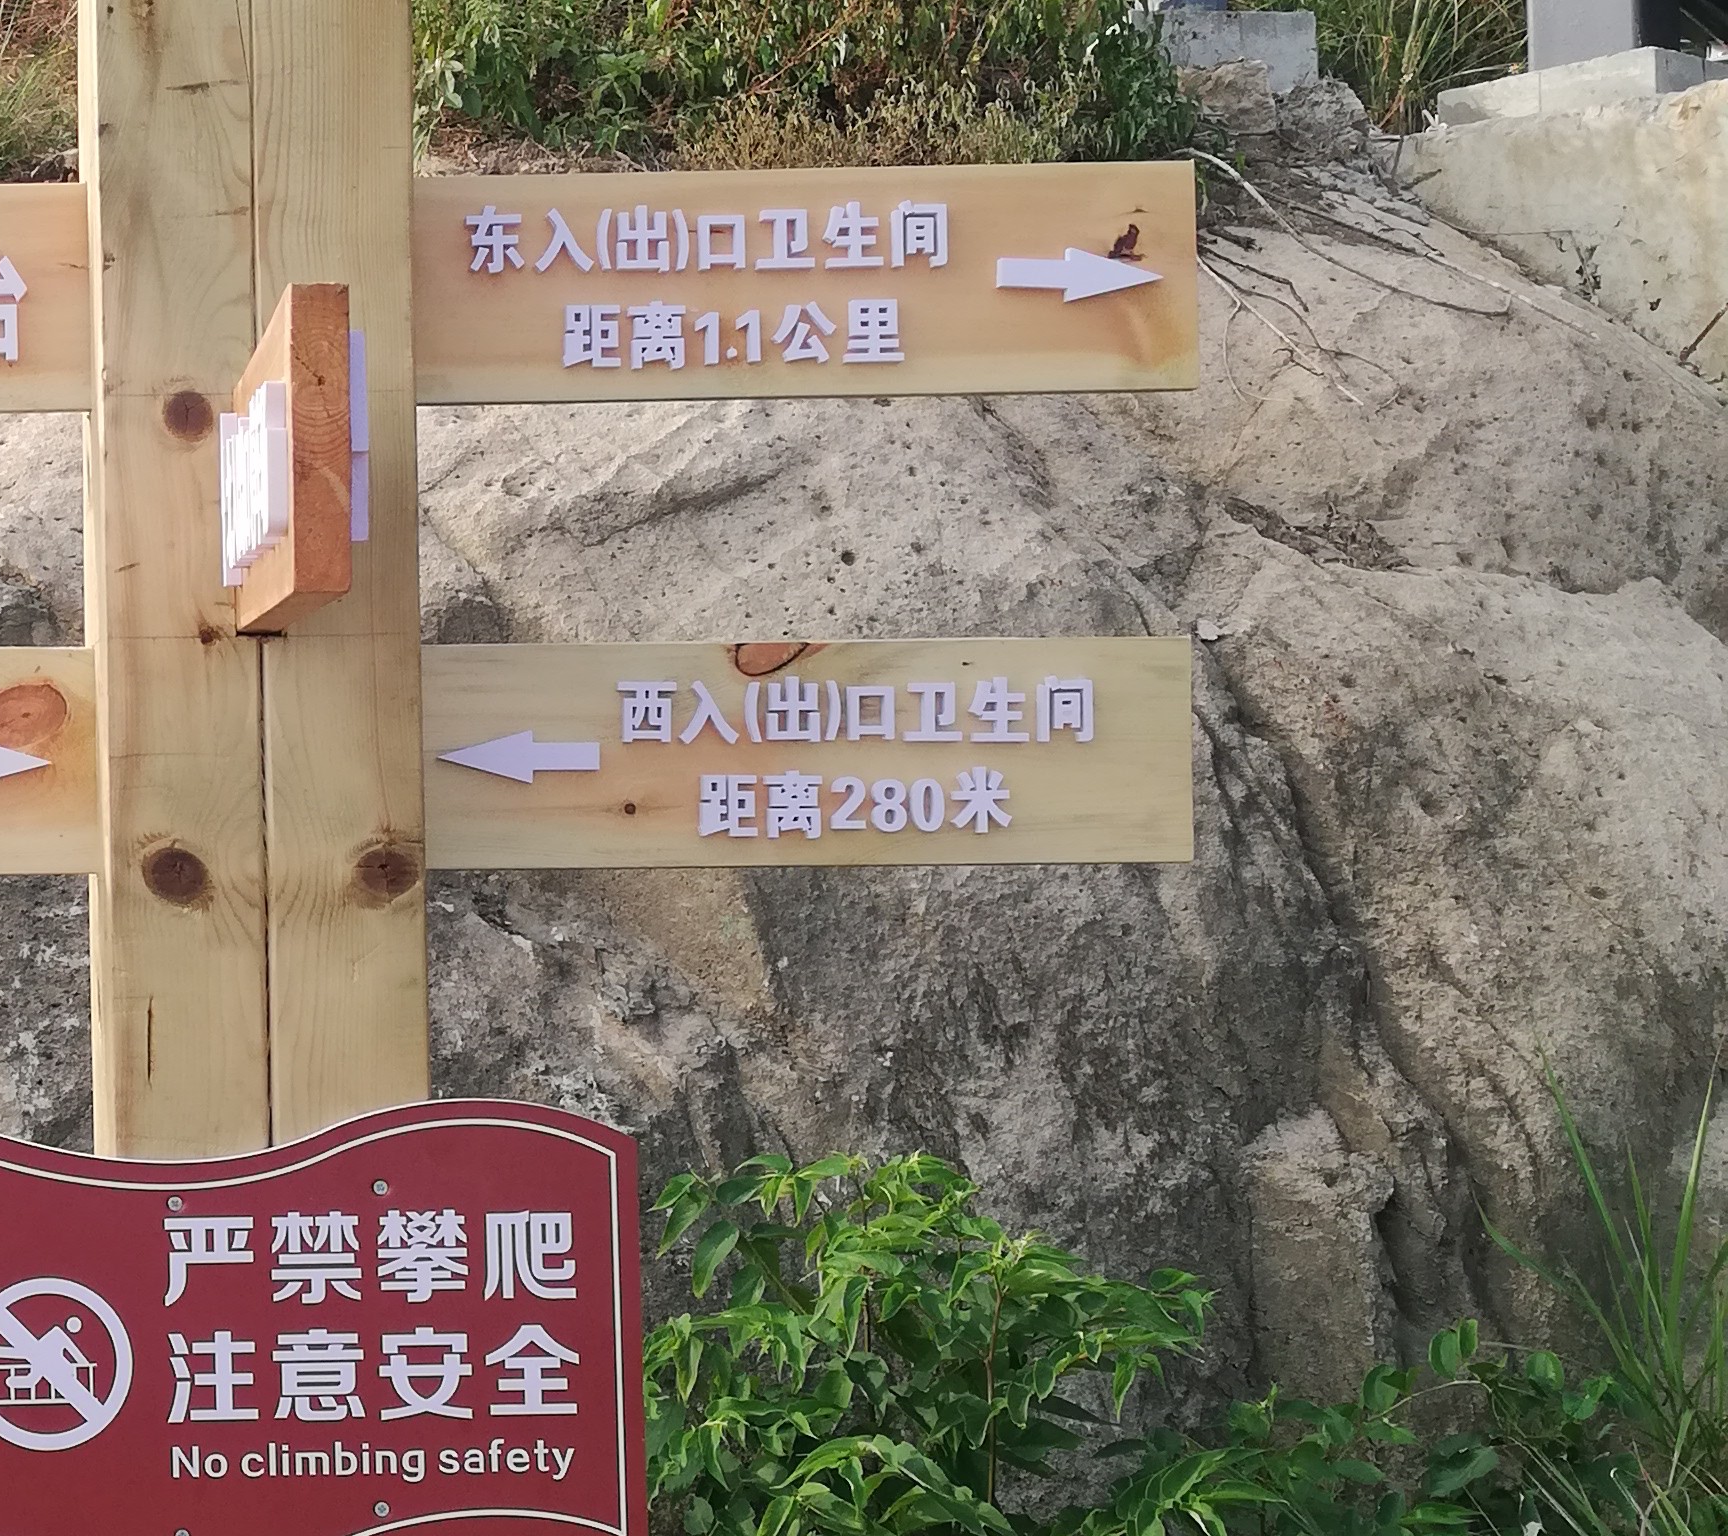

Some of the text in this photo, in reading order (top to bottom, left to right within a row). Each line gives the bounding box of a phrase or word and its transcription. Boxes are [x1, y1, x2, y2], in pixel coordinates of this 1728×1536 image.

[464, 199, 951, 276] 东入(出)口卫生间
[562, 298, 905, 370] 距离1.1公里
[617, 675, 1094, 746] 西入(出)口卫生间
[698, 765, 1011, 840] 距离280米
[163, 1209, 578, 1306] 严禁攀爬
[167, 1324, 580, 1424] 注意安全
[172, 1439, 575, 1482] No climbing safety
